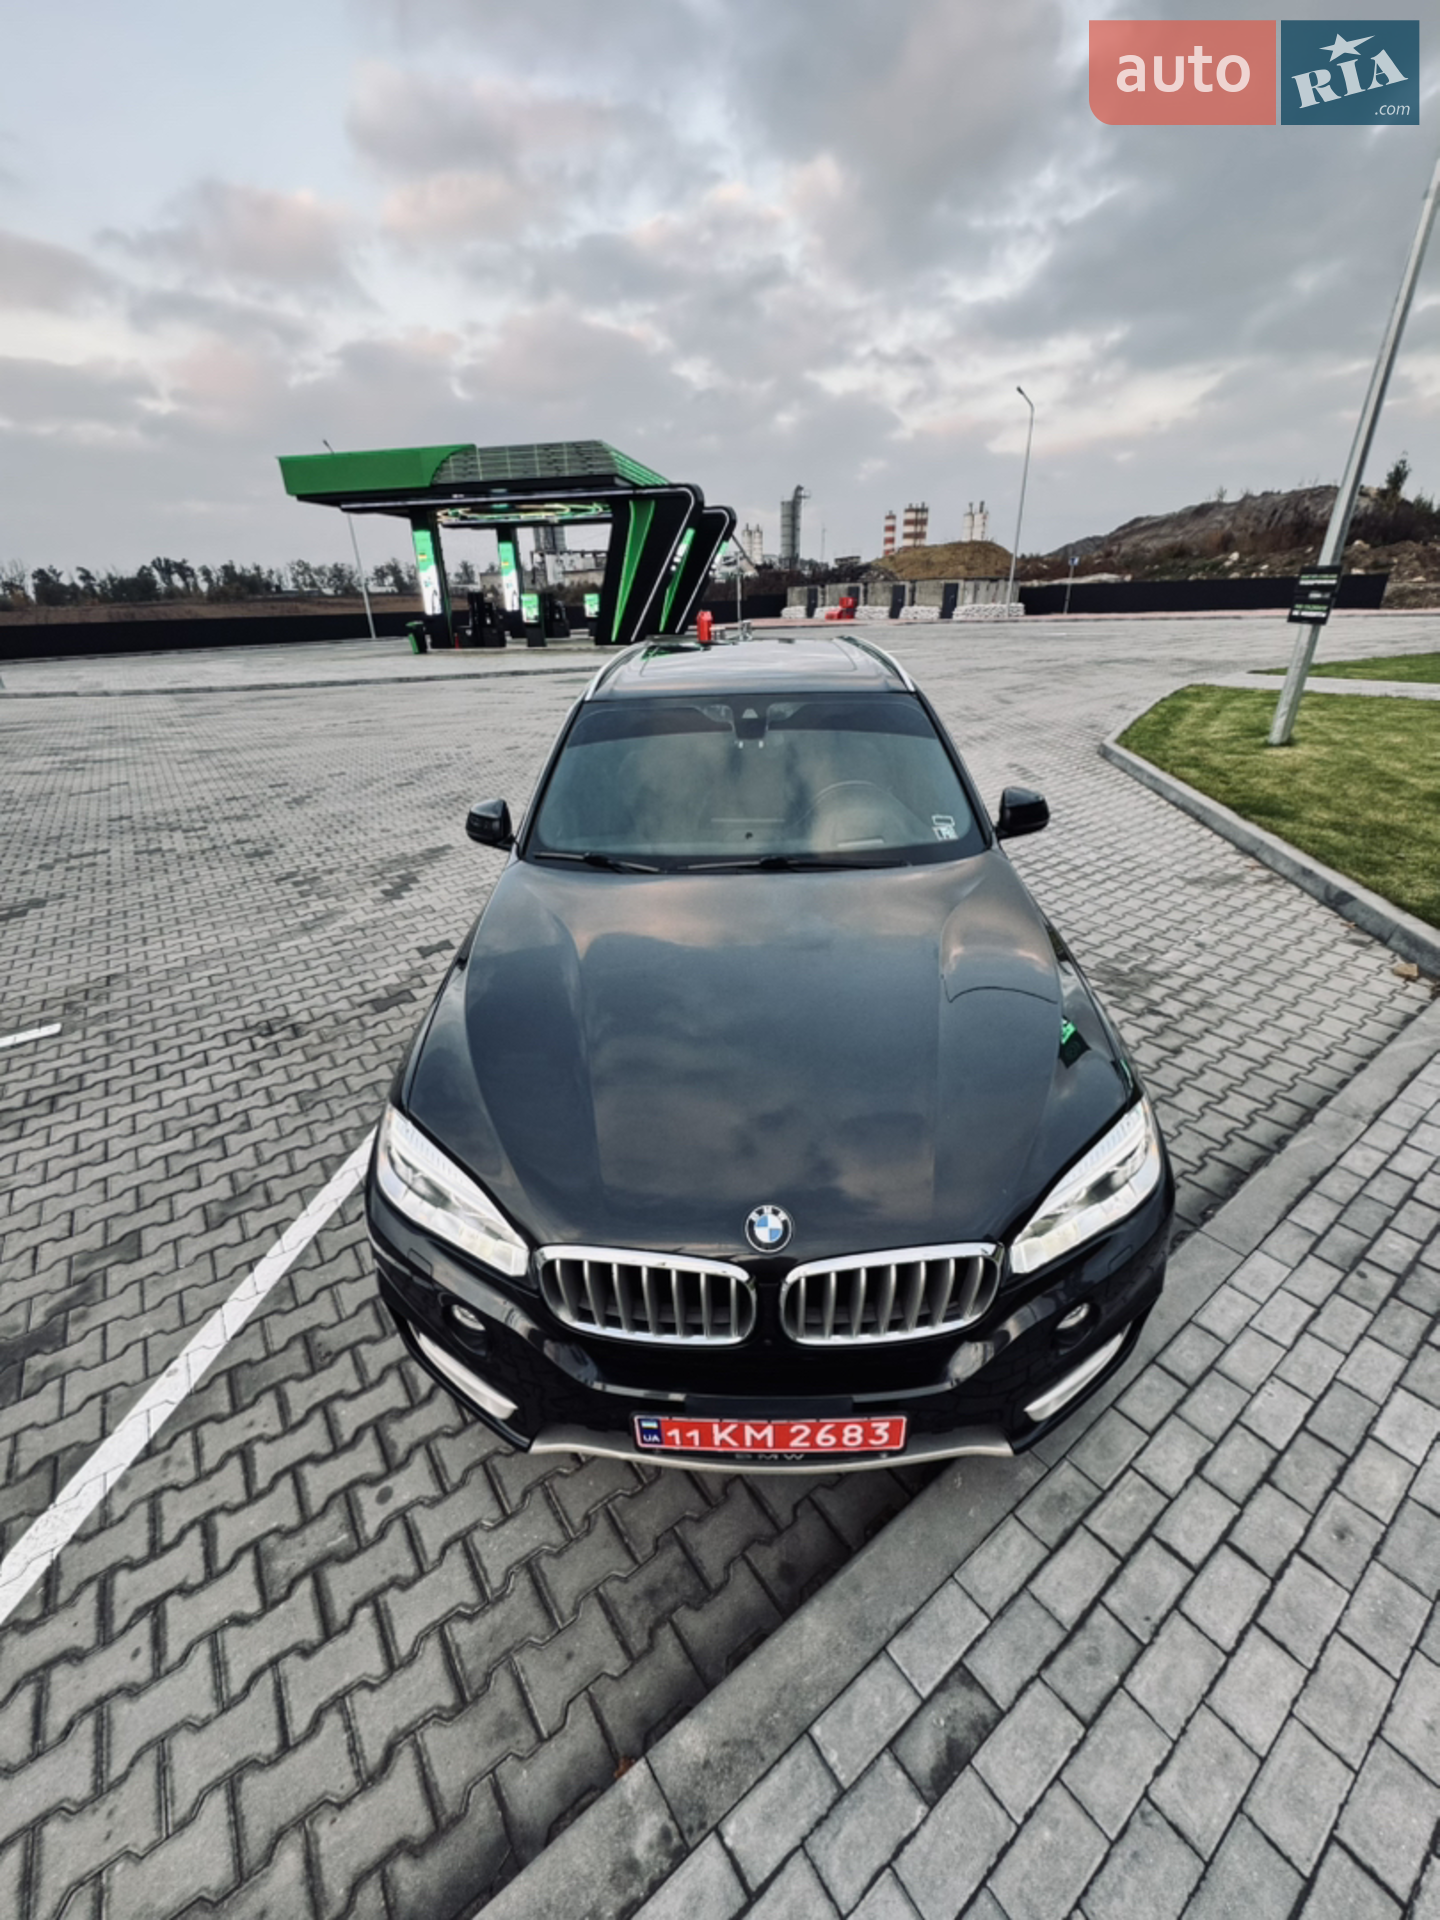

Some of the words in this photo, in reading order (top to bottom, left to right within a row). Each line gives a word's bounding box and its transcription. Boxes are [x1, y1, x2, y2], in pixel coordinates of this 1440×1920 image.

[643, 1434, 660, 1443] UA
[667, 1428, 700, 1446] 11
[712, 1423, 774, 1448] KM
[789, 1422, 890, 1448] 2683
